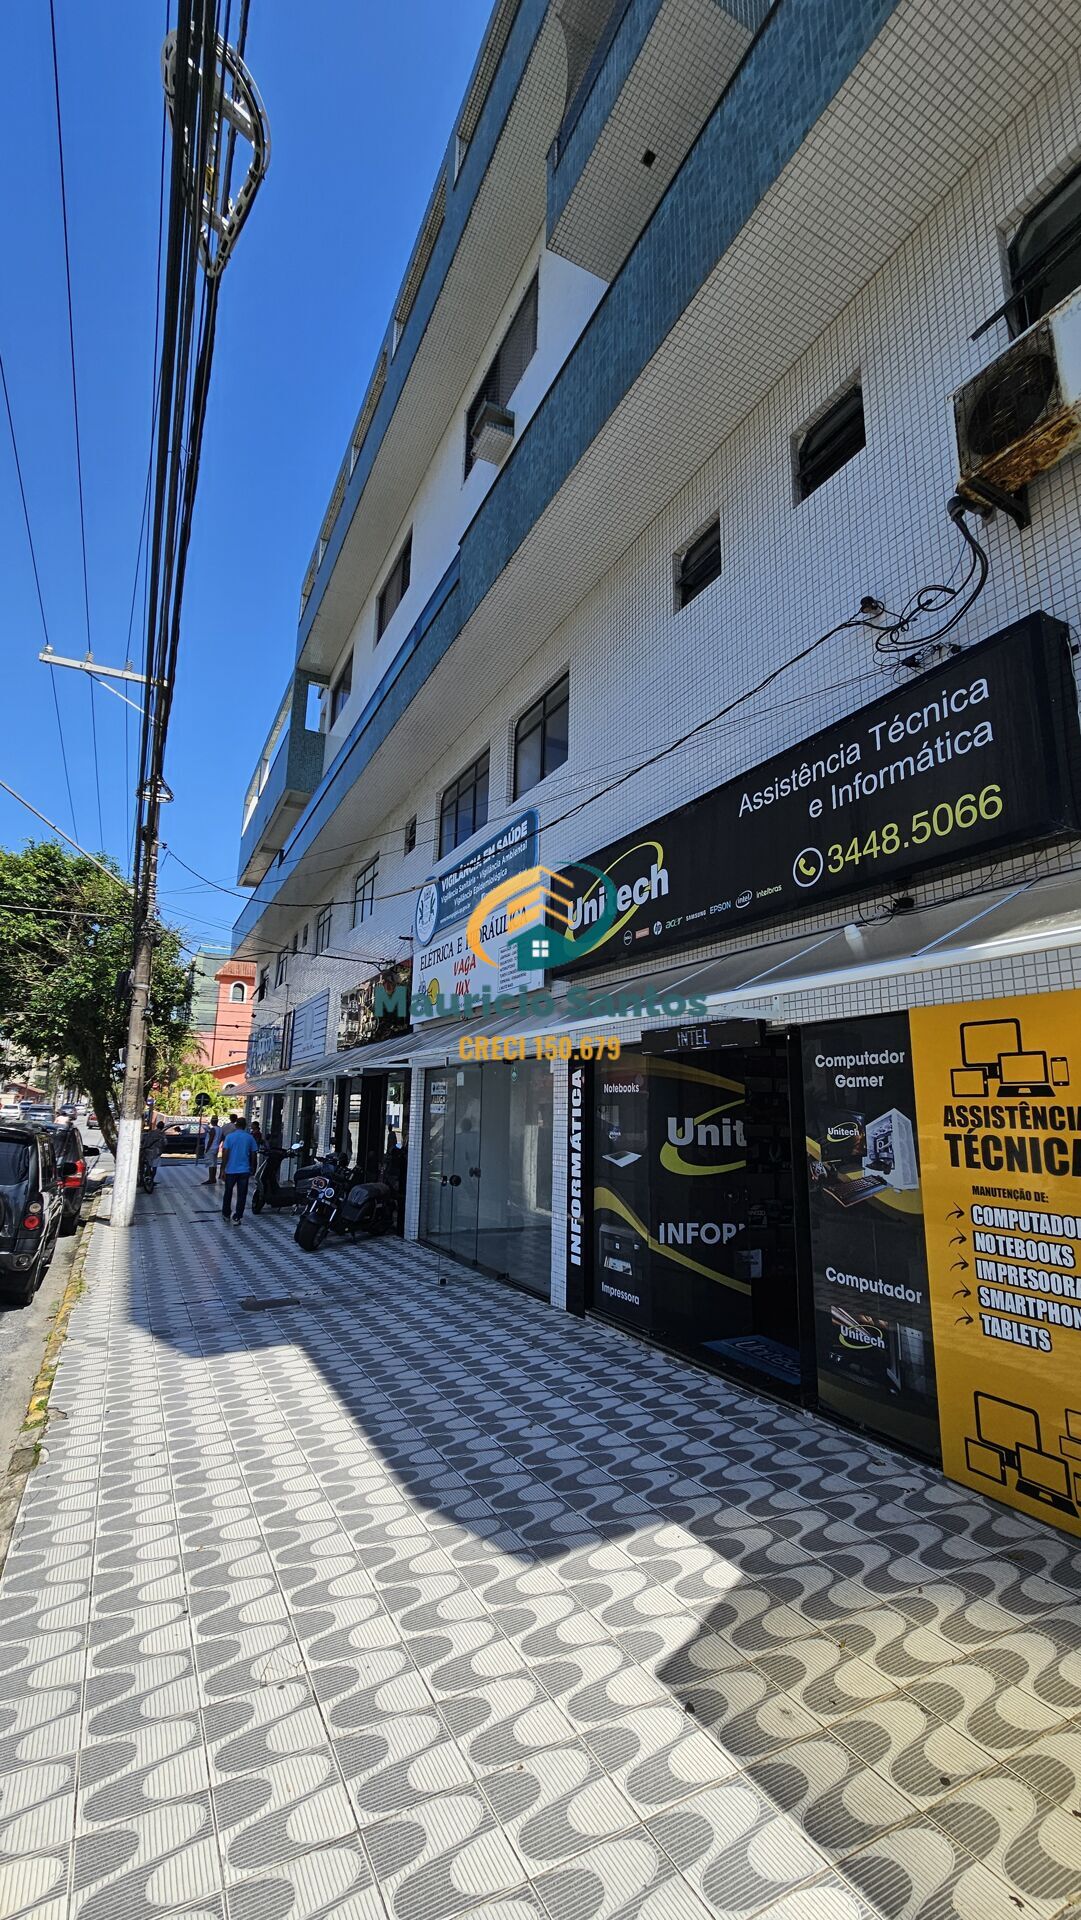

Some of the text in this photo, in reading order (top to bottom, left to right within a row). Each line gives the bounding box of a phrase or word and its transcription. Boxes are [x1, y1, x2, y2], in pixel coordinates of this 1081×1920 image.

[738, 678, 990, 817] Assistência Técnica
[809, 720, 994, 818] e Informática
[496, 820, 528, 852] SAÚDE
[827, 784, 1003, 873] 3448.5066
[567, 863, 669, 930] Uniech
[685, 909, 707, 922] SAMSUNG
[709, 901, 732, 915] EPSON
[756, 884, 783, 899] intelbras
[420, 940, 454, 971] ELÉTRICA
[457, 937, 463, 954] E
[453, 954, 477, 976] VAGA
[815, 1050, 905, 1069] Computador
[603, 1082, 640, 1094] Notebooks
[835, 1074, 884, 1088] Gamer
[828, 1127, 860, 1136] Unitech
[972, 1185, 1049, 1203] MANUTENÇÃO DE:
[974, 1231, 1076, 1268] NOTEBOOKS
[601, 1281, 640, 1305] Impressora
[825, 1267, 922, 1304] Computador
[840, 1325, 886, 1349] Unitech
[979, 1312, 1053, 1352] TABLETS
